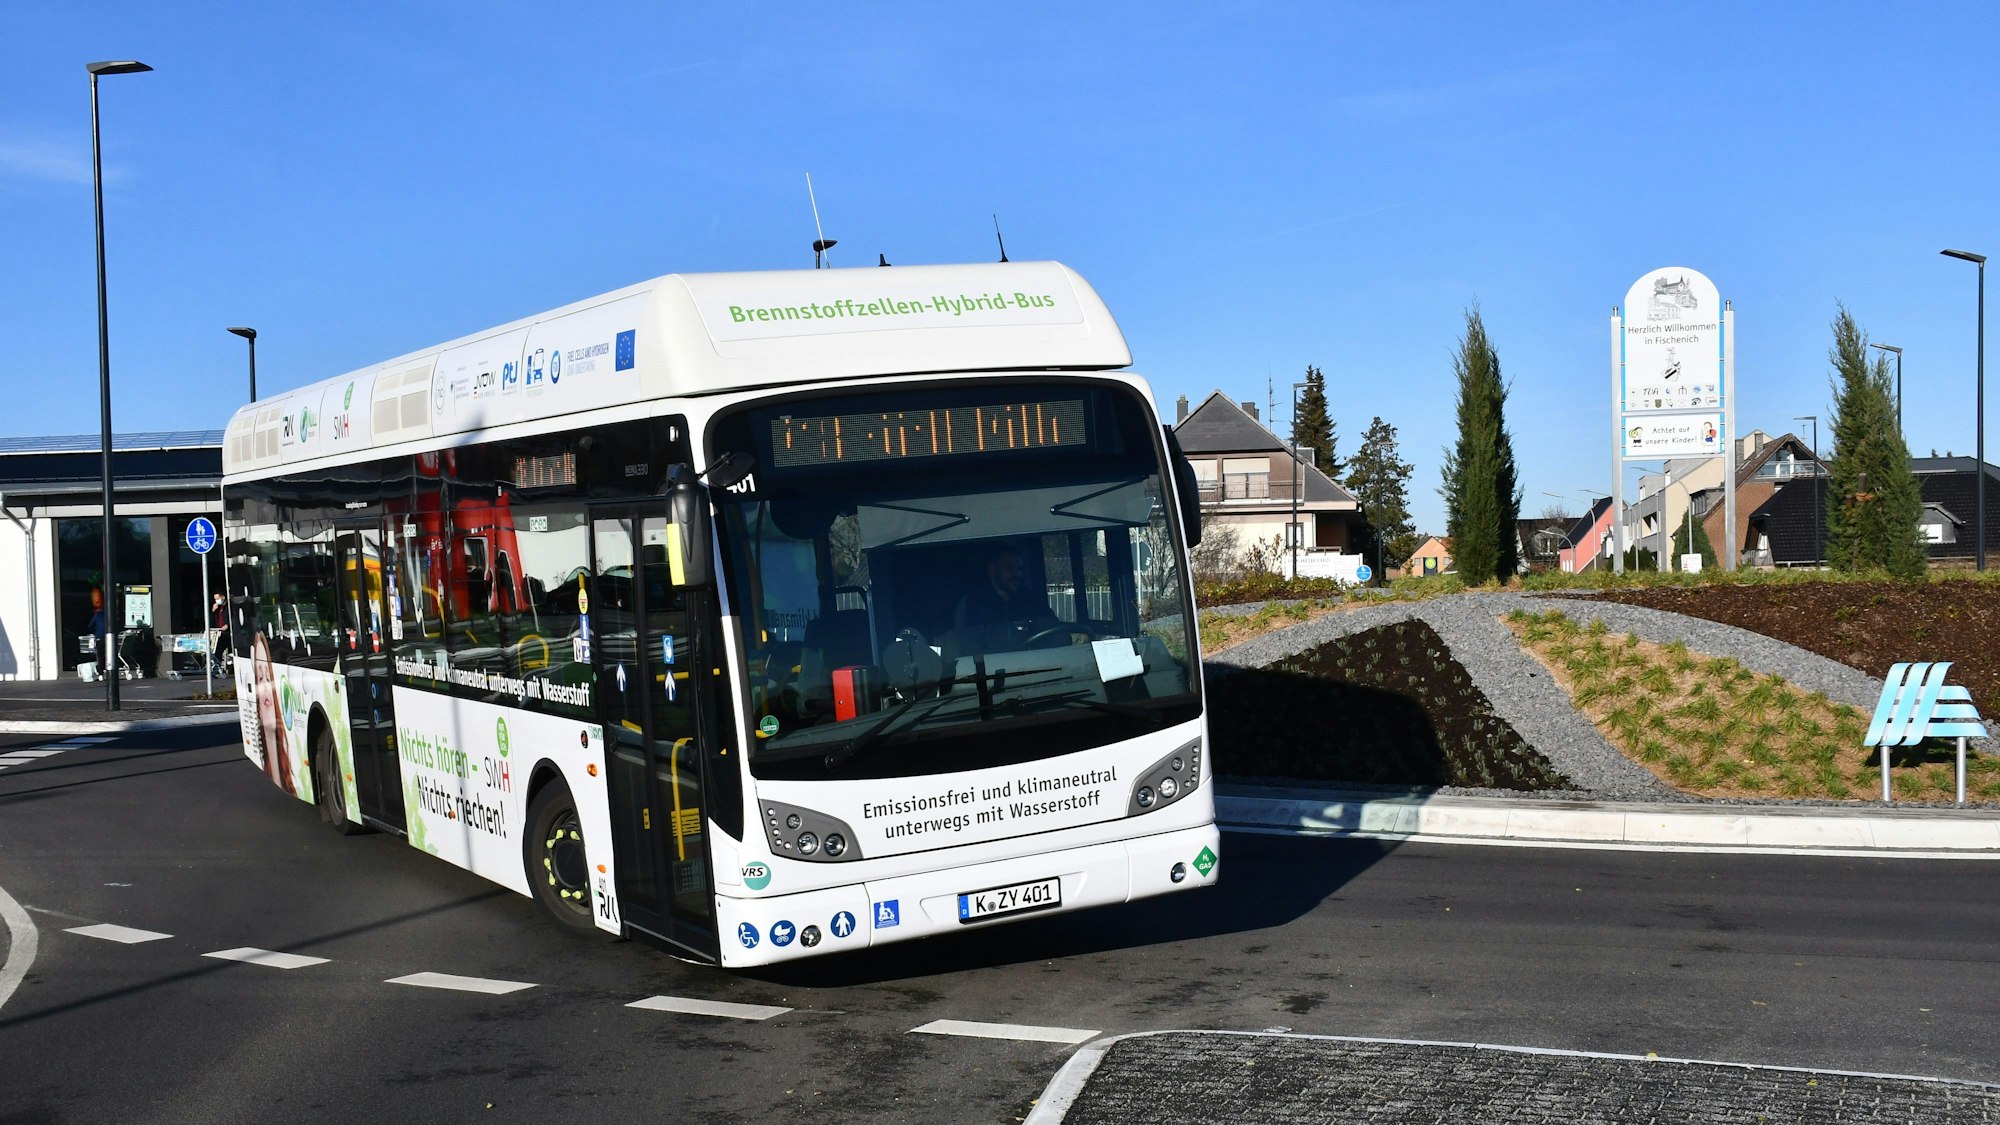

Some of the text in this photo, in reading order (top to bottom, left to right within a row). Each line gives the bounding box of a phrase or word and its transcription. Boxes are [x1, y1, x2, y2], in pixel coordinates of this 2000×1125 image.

[728, 291, 1056, 323] Brennstoffzellen-Hybrid-Bus
[1628, 322, 1717, 334] Herzlich Willkommen
[1645, 335, 1699, 345] in Fischenich
[333, 413, 349, 440] SWH
[1652, 426, 1690, 435] Achtet auf
[1672, 436, 1698, 444] Kinder!
[395, 656, 590, 707] Emissionsfrei und klimaneutral unterwegs mit Wasserstoff
[400, 727, 434, 769] Nichts
[485, 756, 511, 793] SWH
[416, 773, 507, 839] Nichts riechen!
[863, 765, 1117, 819] Emissionsfrei und klimaneutral
[885, 790, 1101, 839] unterwegs mit Wasserstoff
[742, 867, 763, 877] VRS
[1199, 861, 1212, 870] GAS
[976, 884, 1052, 913] K ZY 401
